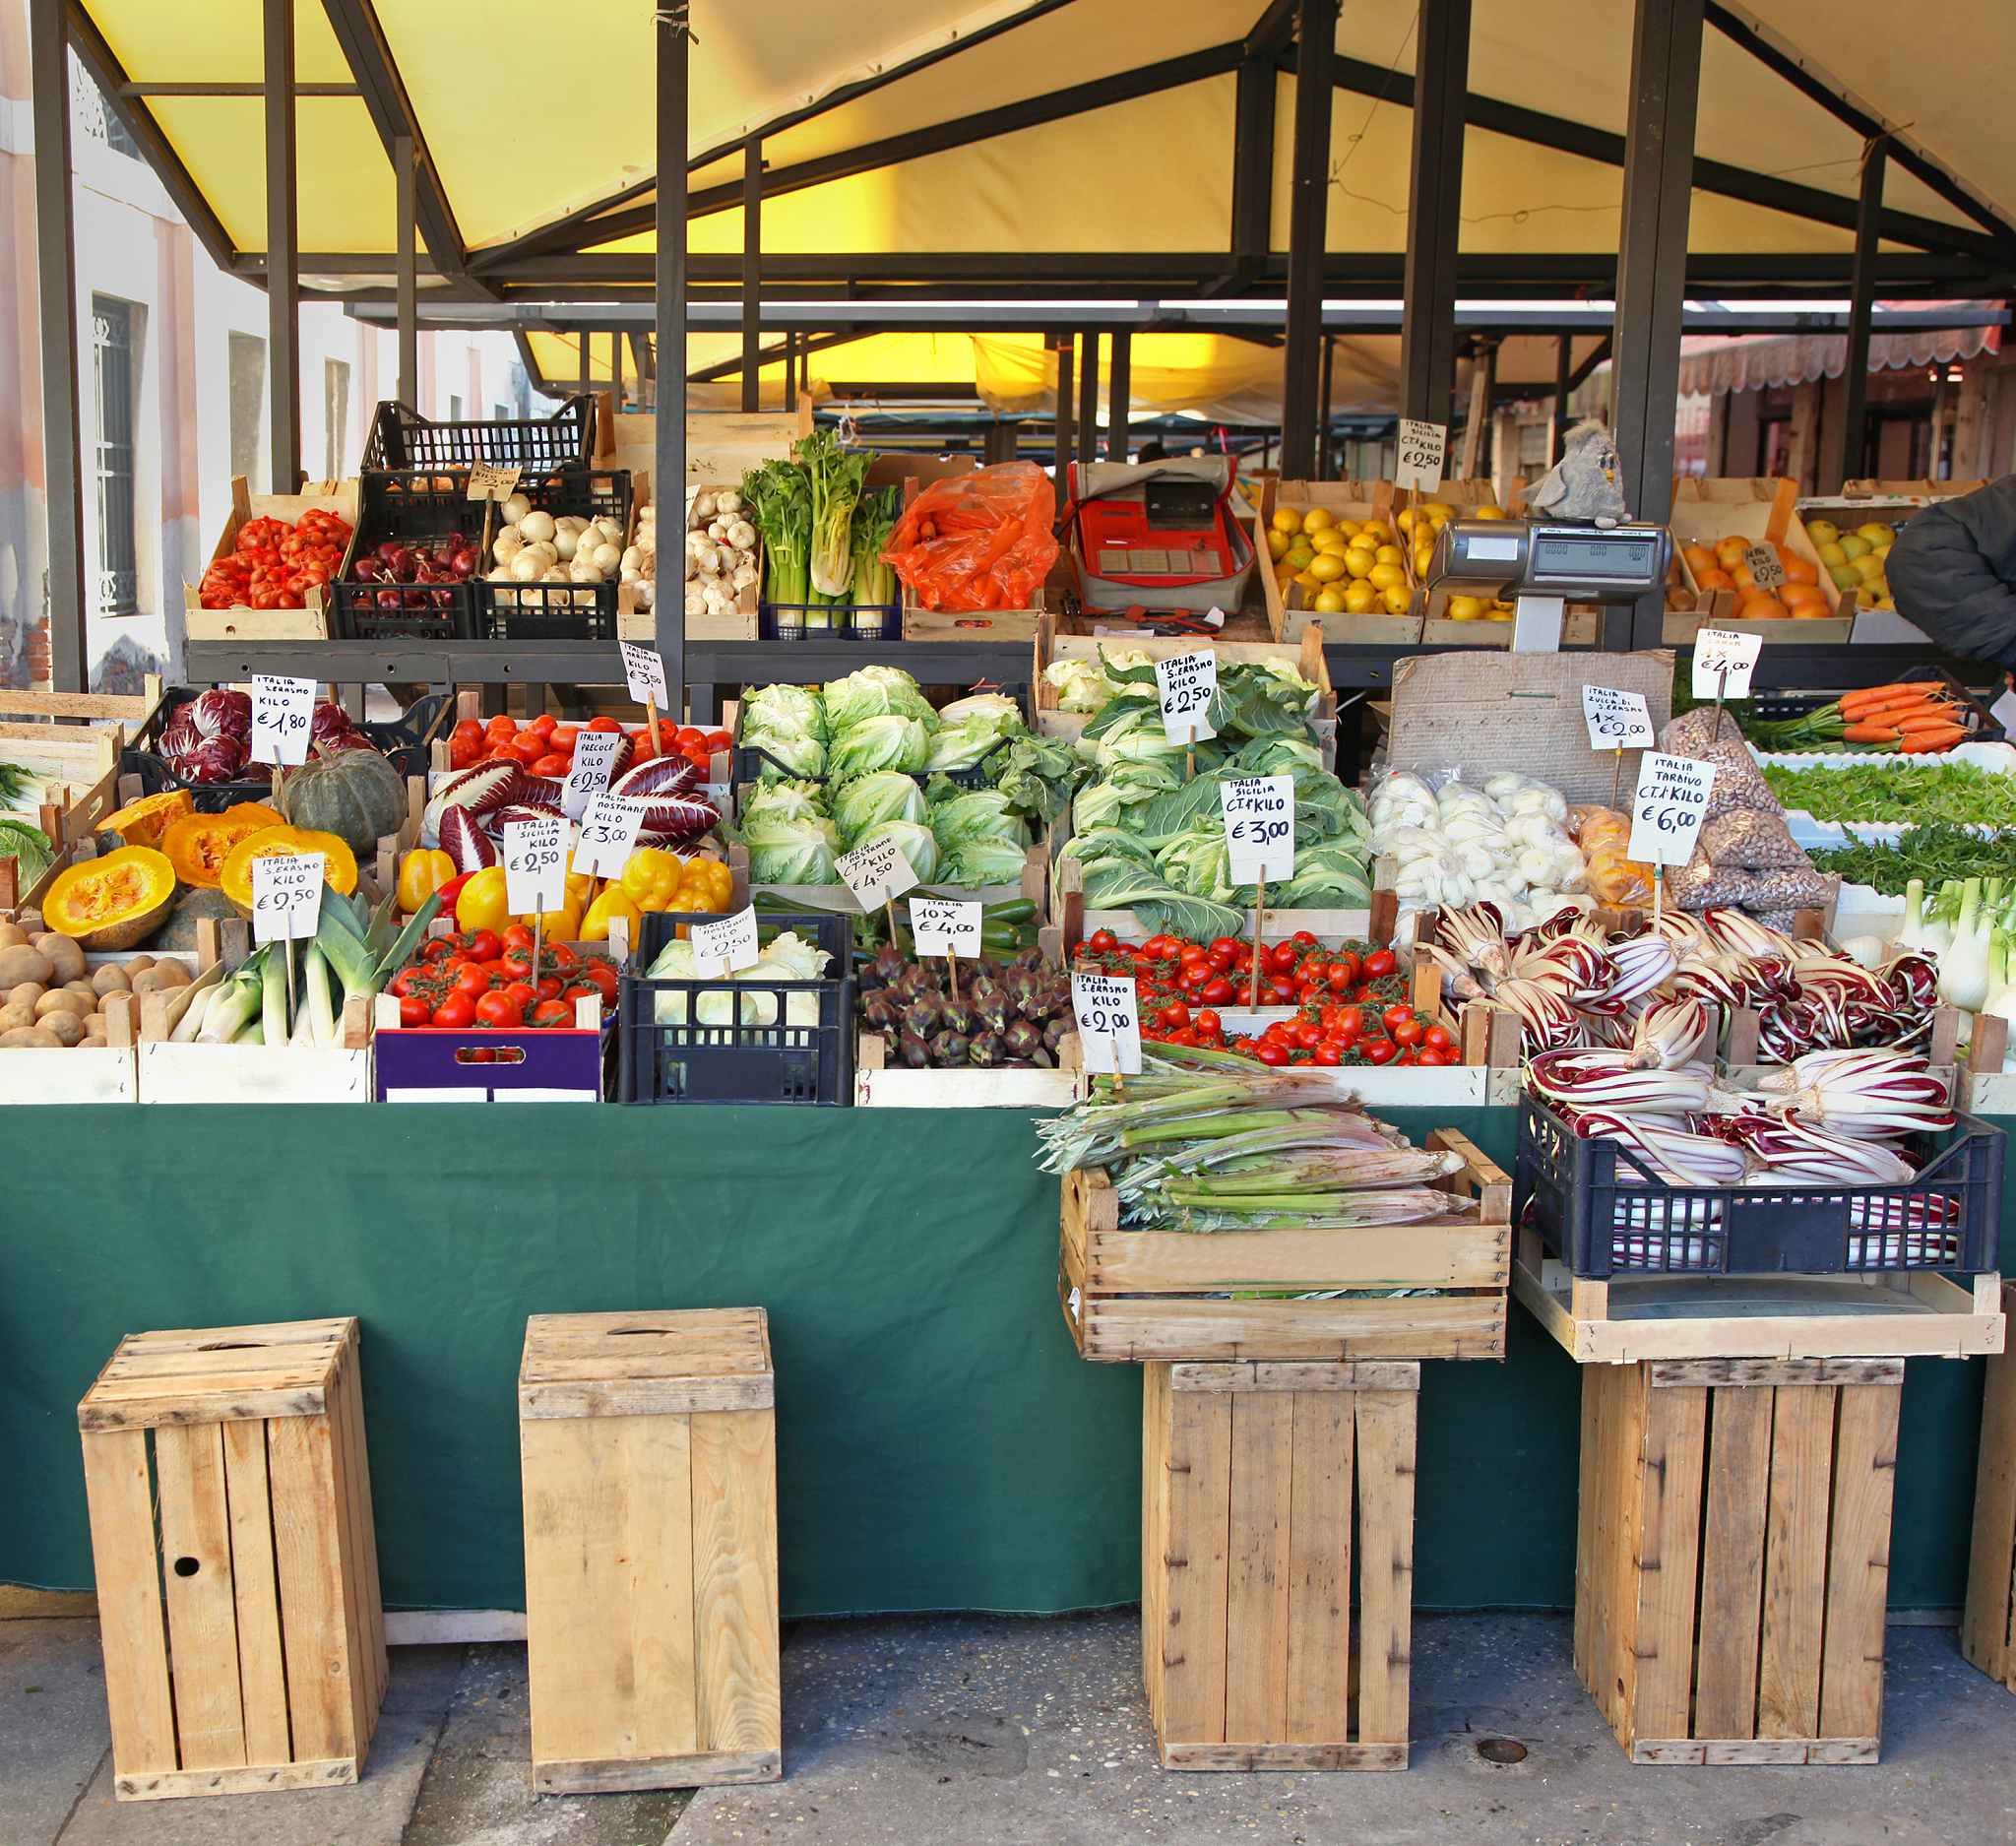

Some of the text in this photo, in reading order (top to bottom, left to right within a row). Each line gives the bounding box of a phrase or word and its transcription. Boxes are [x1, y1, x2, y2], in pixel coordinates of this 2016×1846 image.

[1406, 420, 1434, 431] ITALIA
[1412, 428, 1442, 439] SICILIA
[1419, 440, 1442, 452] KILO
[1752, 555, 1771, 567] KILO
[624, 644, 649, 656] ITALIA
[628, 659, 650, 670] KILO
[1161, 655, 1196, 670] ITALIA
[1167, 660, 1213, 678] S.ERASMO
[257, 676, 295, 685] ITALIA
[1168, 675, 1197, 692] KILO
[1589, 687, 1618, 698] ITALIA
[259, 696, 290, 706] KILO
[1598, 704, 1643, 713] S.ERASMO
[581, 743, 615, 752] PRECOCE
[581, 757, 603, 767] KILO
[1655, 758, 1693, 772] ITALIA
[1230, 778, 1261, 789] ITALIA
[1655, 771, 1702, 787] TARDIVO
[1235, 785, 1275, 796] SICILIA
[1670, 786, 1704, 803] KILO
[596, 793, 626, 802] ITALIA
[1254, 797, 1285, 813] KILO
[594, 811, 623, 823] KILO
[517, 819, 559, 830] ITALIA
[520, 828, 560, 838] SICILIA
[530, 837, 558, 850] KILO
[840, 843, 870, 863] ITALIA
[867, 848, 896, 867] KILO
[263, 857, 299, 866] ITALIA
[265, 862, 319, 875] S.ERASMO
[274, 874, 306, 886] KILO
[698, 920, 730, 931] ITALIA
[711, 928, 737, 941] KILO
[1076, 975, 1108, 986] ITALIA
[1081, 984, 1128, 994] S.ERASMO
[1092, 995, 1121, 1006] KILO
